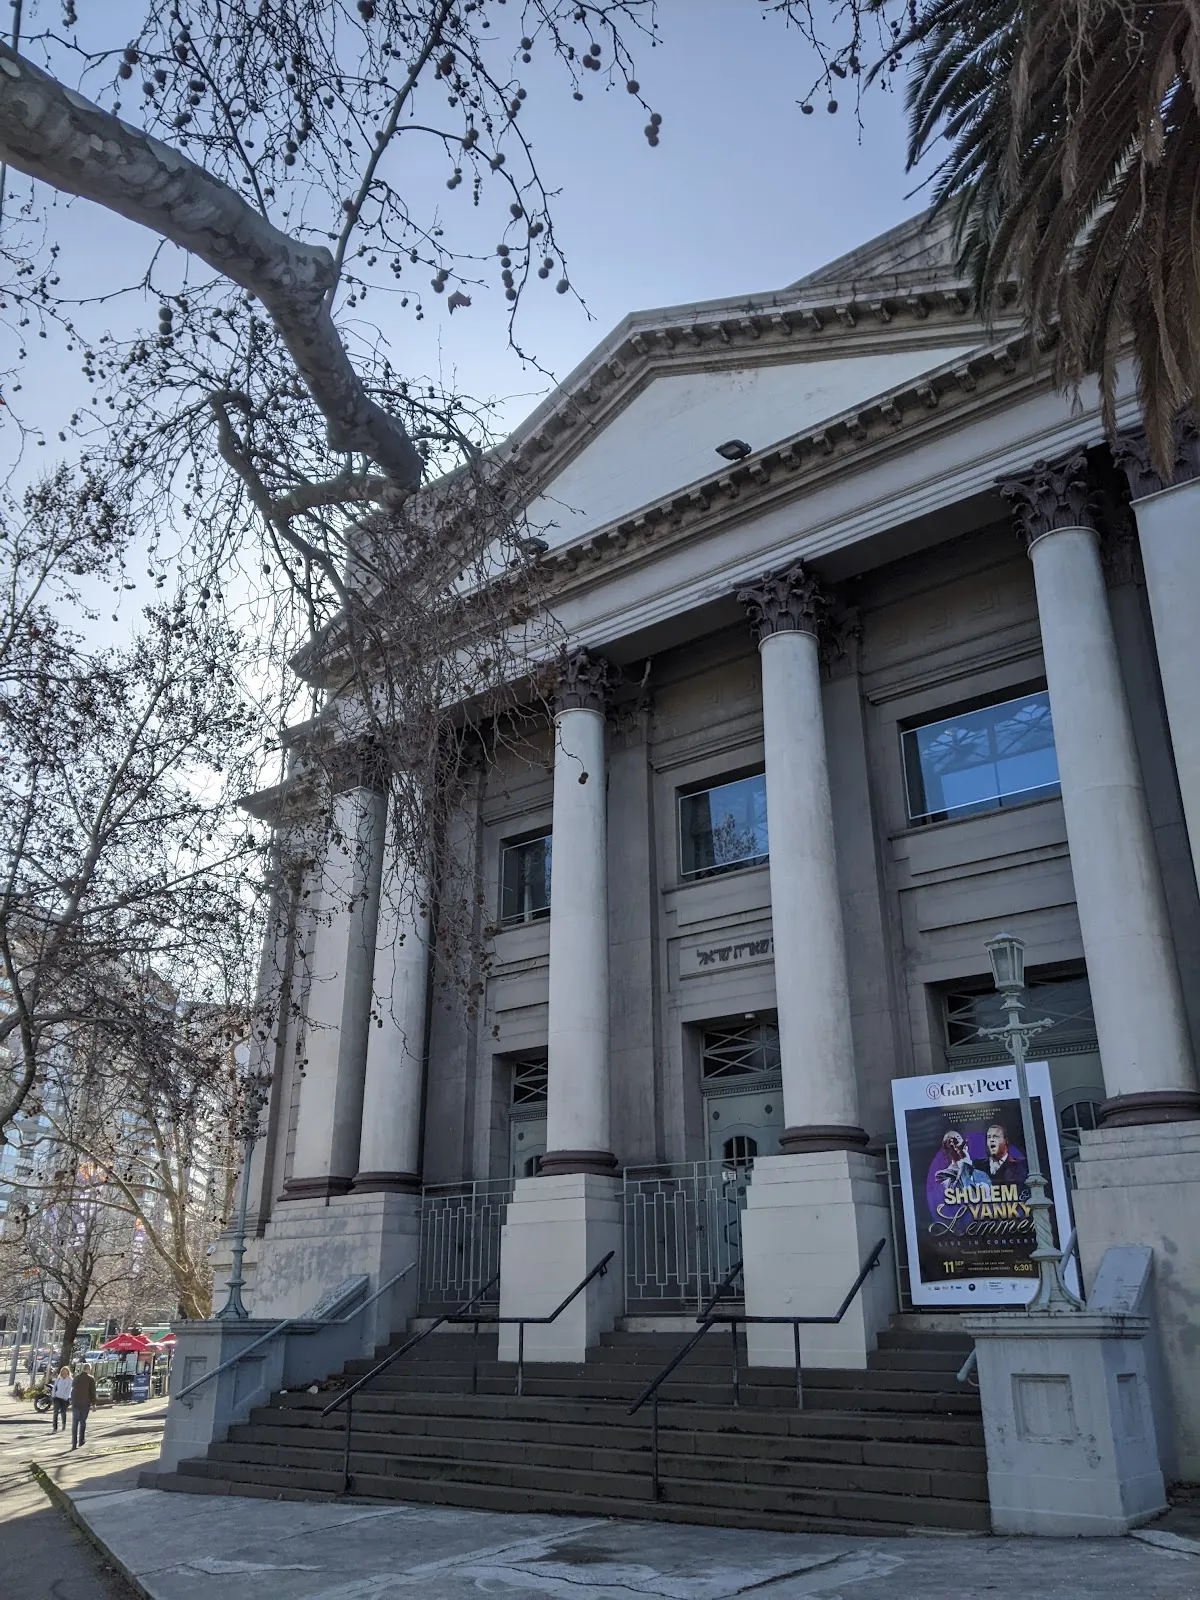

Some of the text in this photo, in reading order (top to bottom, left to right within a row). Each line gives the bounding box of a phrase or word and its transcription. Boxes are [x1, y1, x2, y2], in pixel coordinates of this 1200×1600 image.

[944, 1184, 1030, 1204] SHULEM &
[968, 1202, 1031, 1220] YANKY
[943, 1260, 955, 1273] 11
